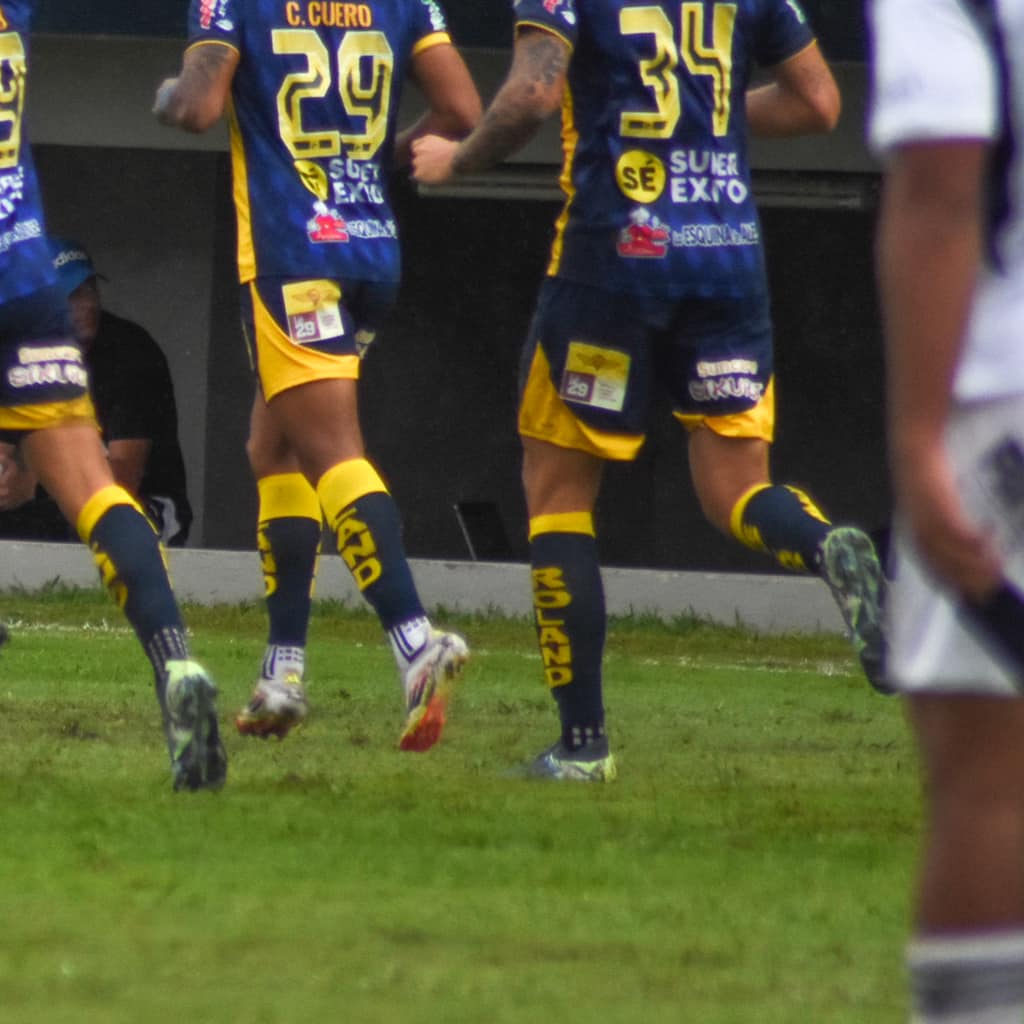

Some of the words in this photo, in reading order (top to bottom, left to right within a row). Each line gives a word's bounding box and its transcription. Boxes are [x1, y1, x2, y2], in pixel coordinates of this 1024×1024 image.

[286, 1, 306, 26] C.
[308, 1, 372, 27] CUERO
[619, 2, 737, 139] 34
[271, 29, 393, 160] 29
